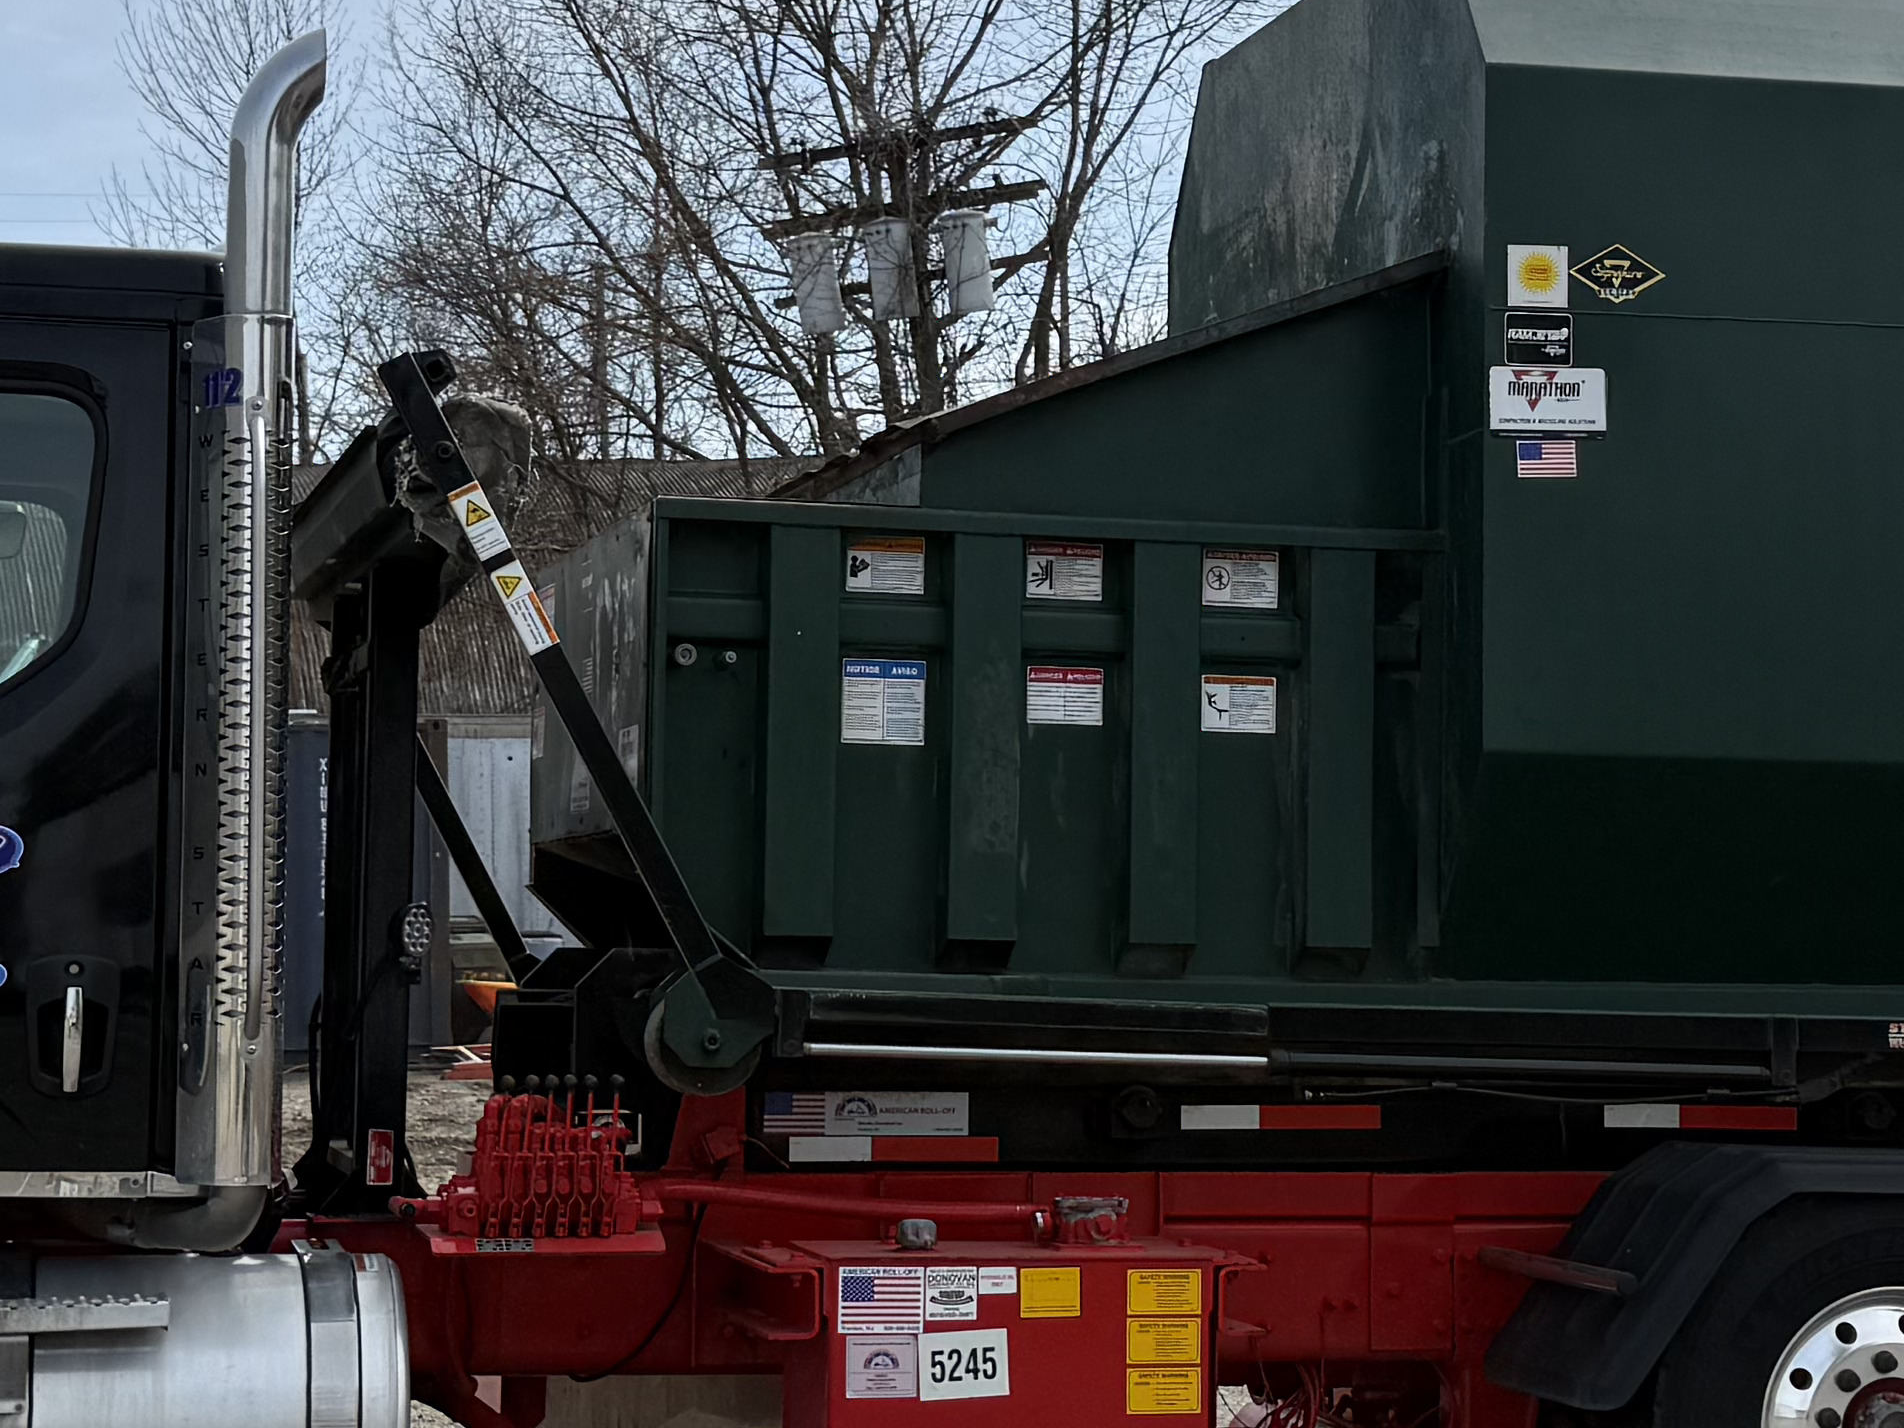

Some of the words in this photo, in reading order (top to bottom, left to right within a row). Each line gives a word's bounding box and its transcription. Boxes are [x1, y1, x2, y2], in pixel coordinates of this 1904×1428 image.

[1507, 381, 1581, 399] MARATHON
[928, 1274, 976, 1283] DONOVAN
[931, 1346, 997, 1384] 5245
